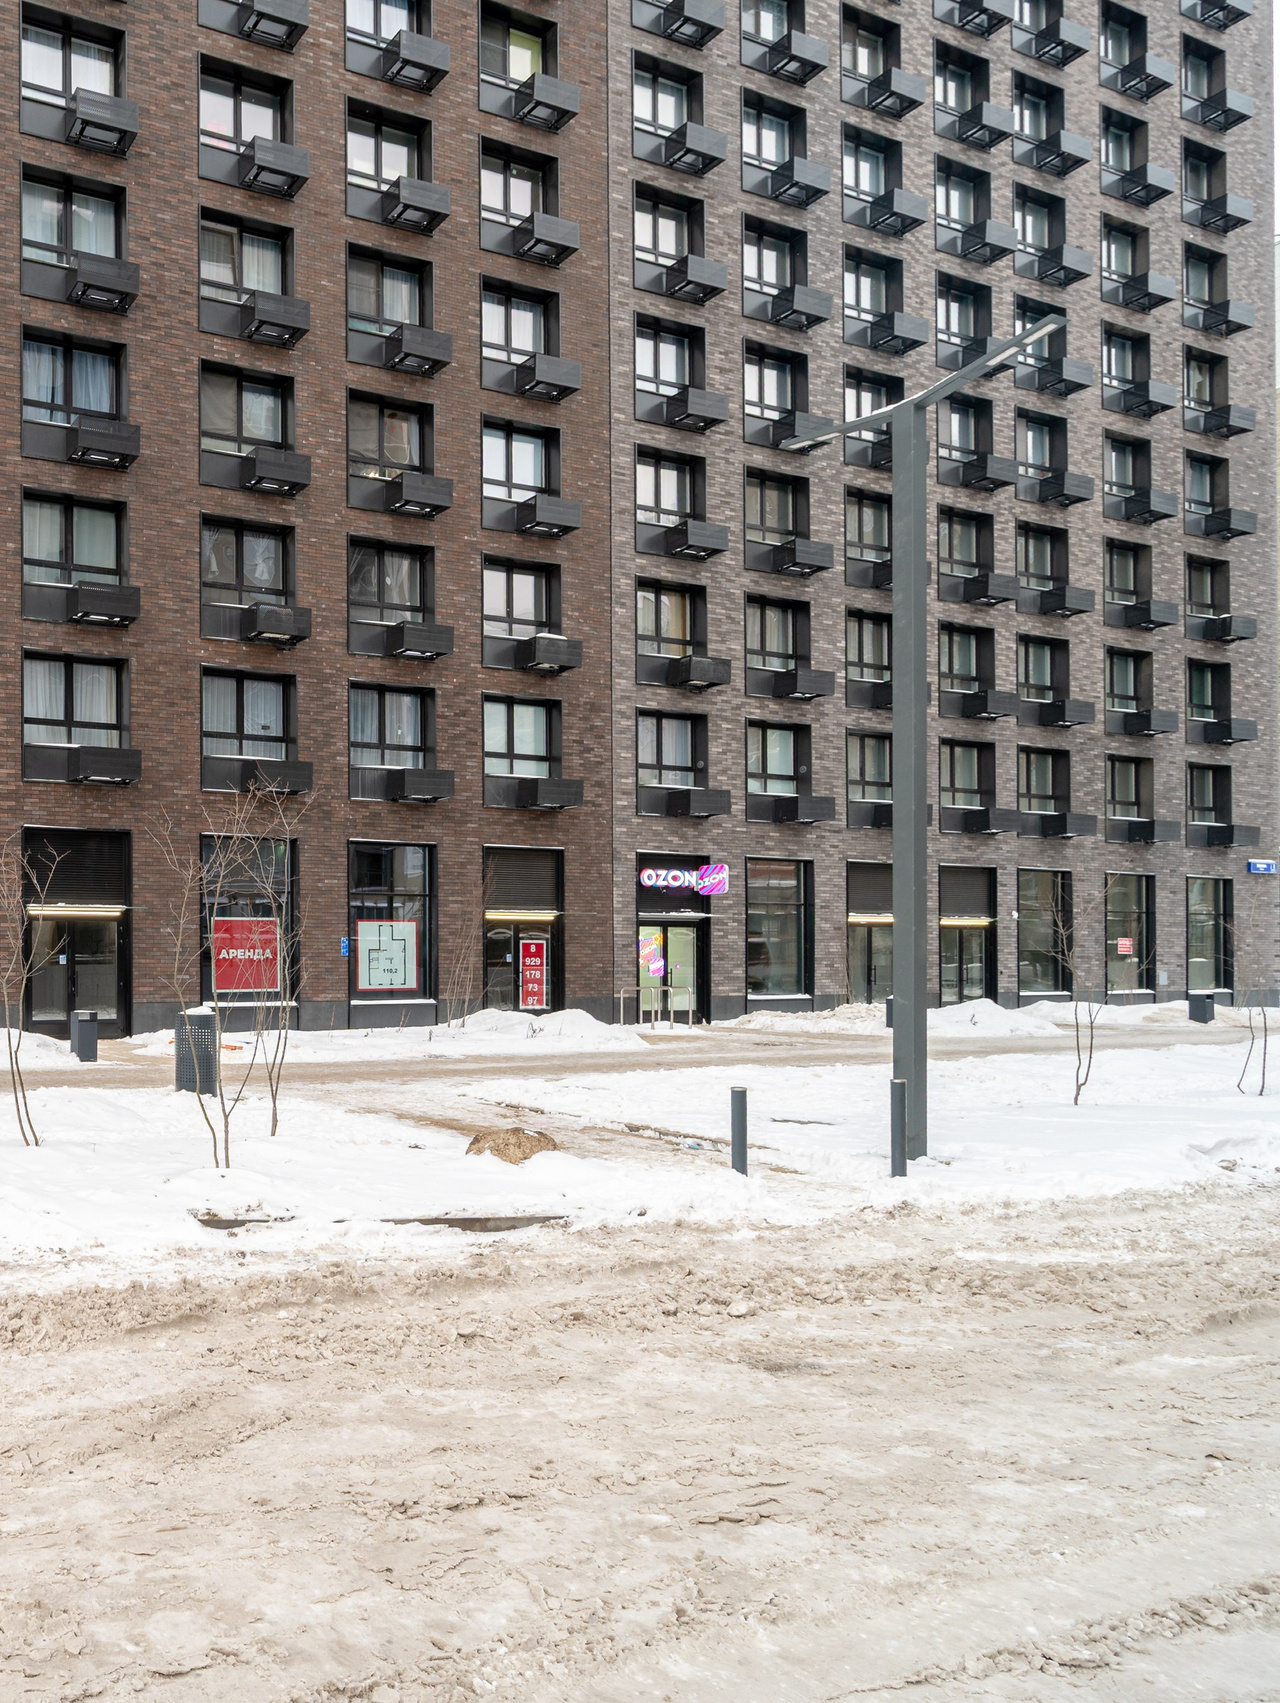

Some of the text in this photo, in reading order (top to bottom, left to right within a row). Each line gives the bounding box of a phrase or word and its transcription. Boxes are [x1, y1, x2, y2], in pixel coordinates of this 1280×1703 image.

[642, 868, 697, 887] OZON
[699, 871, 727, 888] OZON
[530, 944, 536, 953] 8
[218, 948, 273, 961] АРЕНДА
[525, 957, 541, 966] 929
[525, 970, 541, 979] 178
[527, 983, 538, 992] 73
[527, 996, 538, 1005] 97
